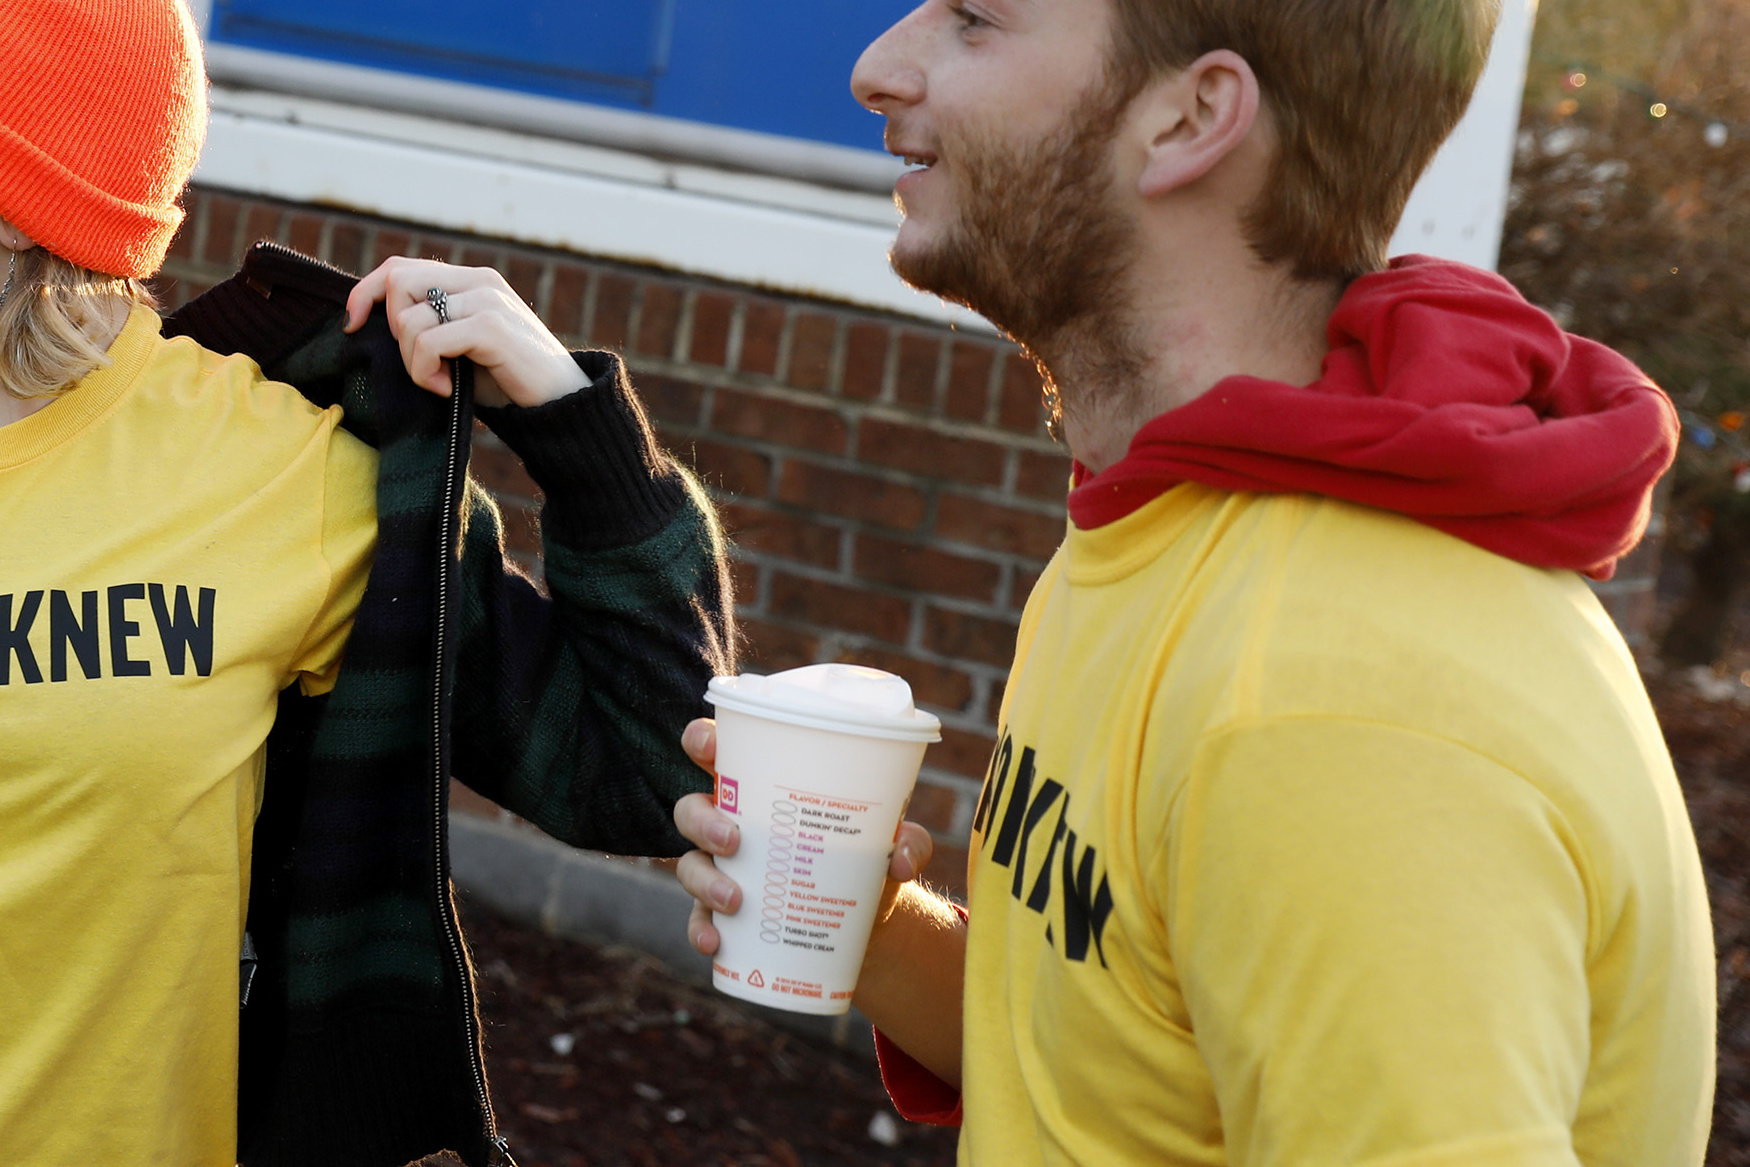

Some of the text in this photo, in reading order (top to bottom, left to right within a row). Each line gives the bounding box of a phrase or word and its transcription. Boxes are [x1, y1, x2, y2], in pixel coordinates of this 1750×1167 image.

[789, 793, 820, 805] FLAVOR
[827, 800, 868, 812] SPECIALTY
[801, 807, 850, 822] DARK ROAST
[798, 831, 823, 842] BLACK
[796, 843, 824, 854] CREAM
[795, 855, 813, 865] MILK
[791, 879, 816, 889] SUGAR
[790, 891, 857, 907] YELLOW SWEETENER
[787, 902, 845, 917] BLUE SWEETENER
[803, 918, 841, 929] SWEETENER
[785, 926, 807, 936] TURBO
[783, 938, 835, 952] WHIPPED CREAM
